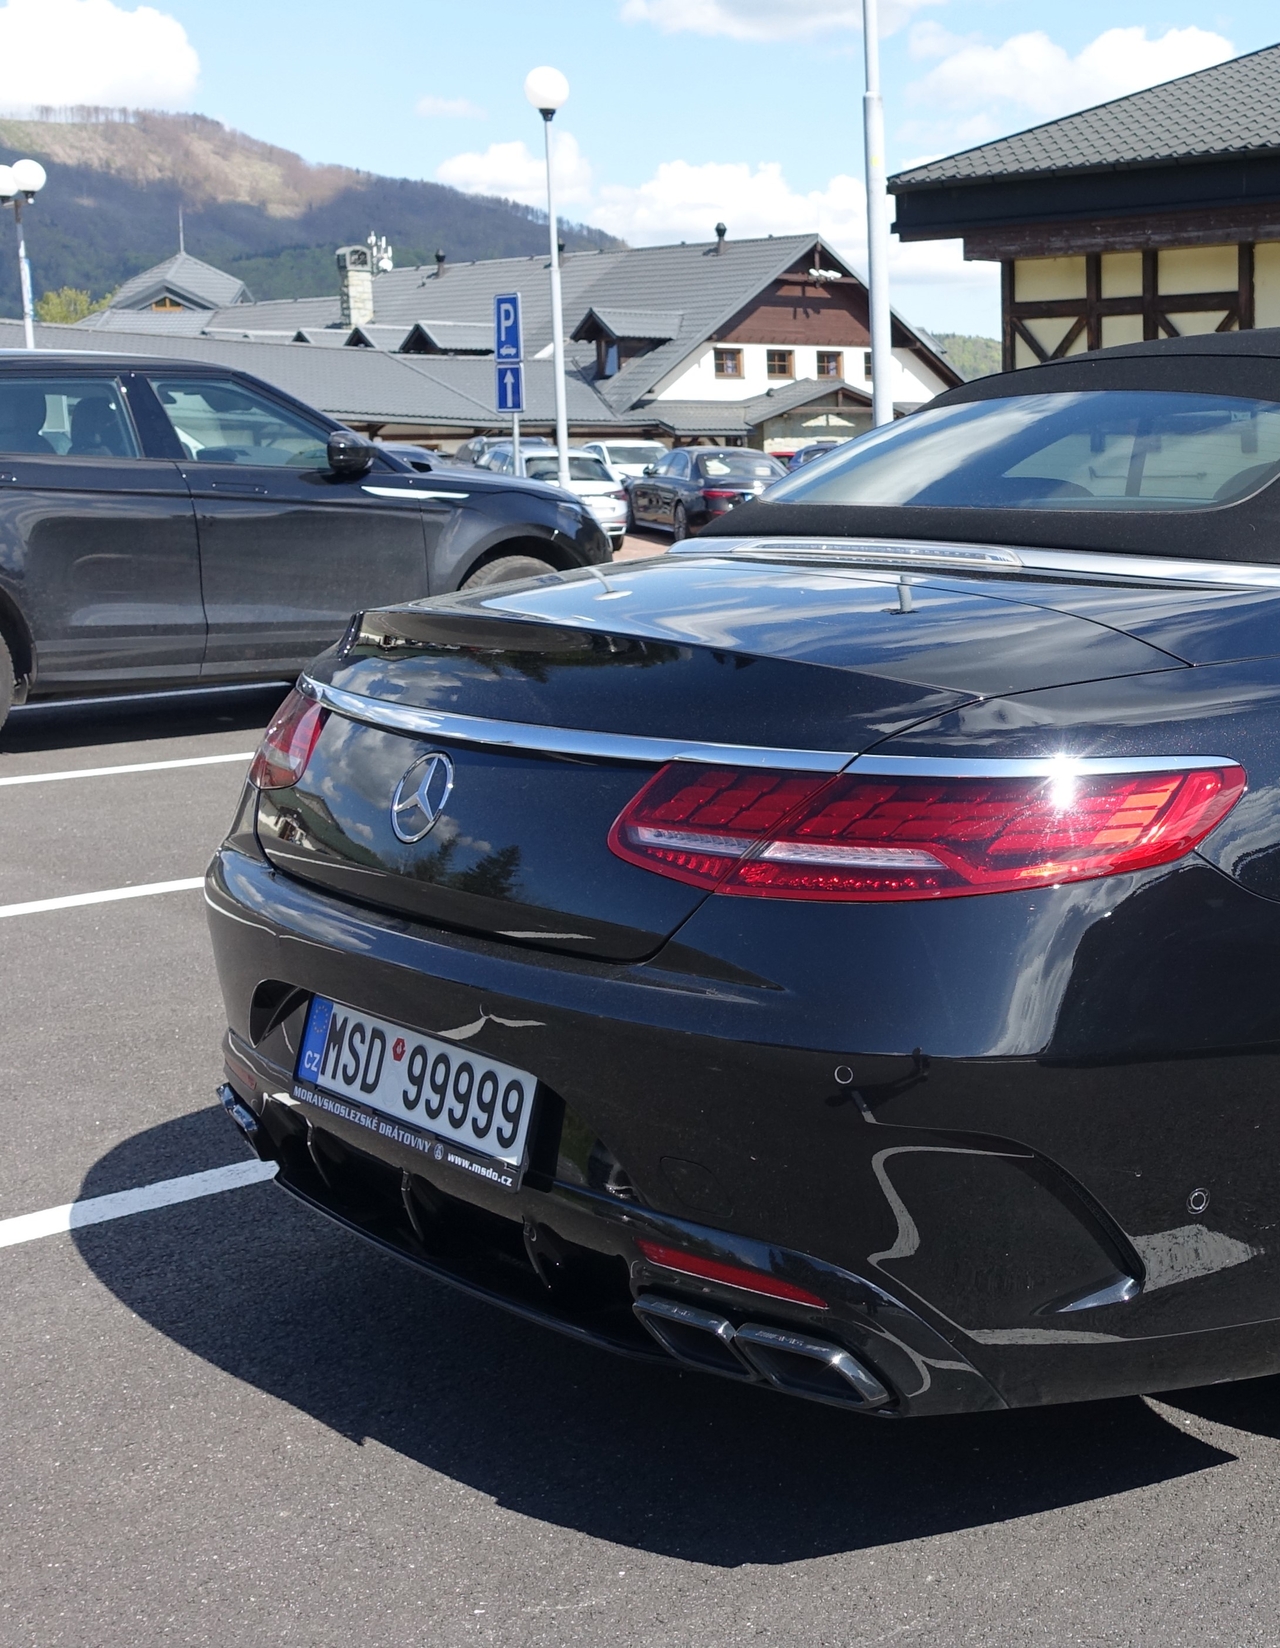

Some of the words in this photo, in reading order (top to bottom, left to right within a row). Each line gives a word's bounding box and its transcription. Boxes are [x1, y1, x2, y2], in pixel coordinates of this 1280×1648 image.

[500, 303, 514, 341] P
[304, 1050, 320, 1071] CZ
[320, 1012, 387, 1094] MSD
[403, 1044, 525, 1149] 99999
[292, 1085, 379, 1132] MORAVSKOSLEZSKÉ
[378, 1121, 432, 1153] DRÁTOVNY
[447, 1152, 513, 1187] www.msdo.cz
